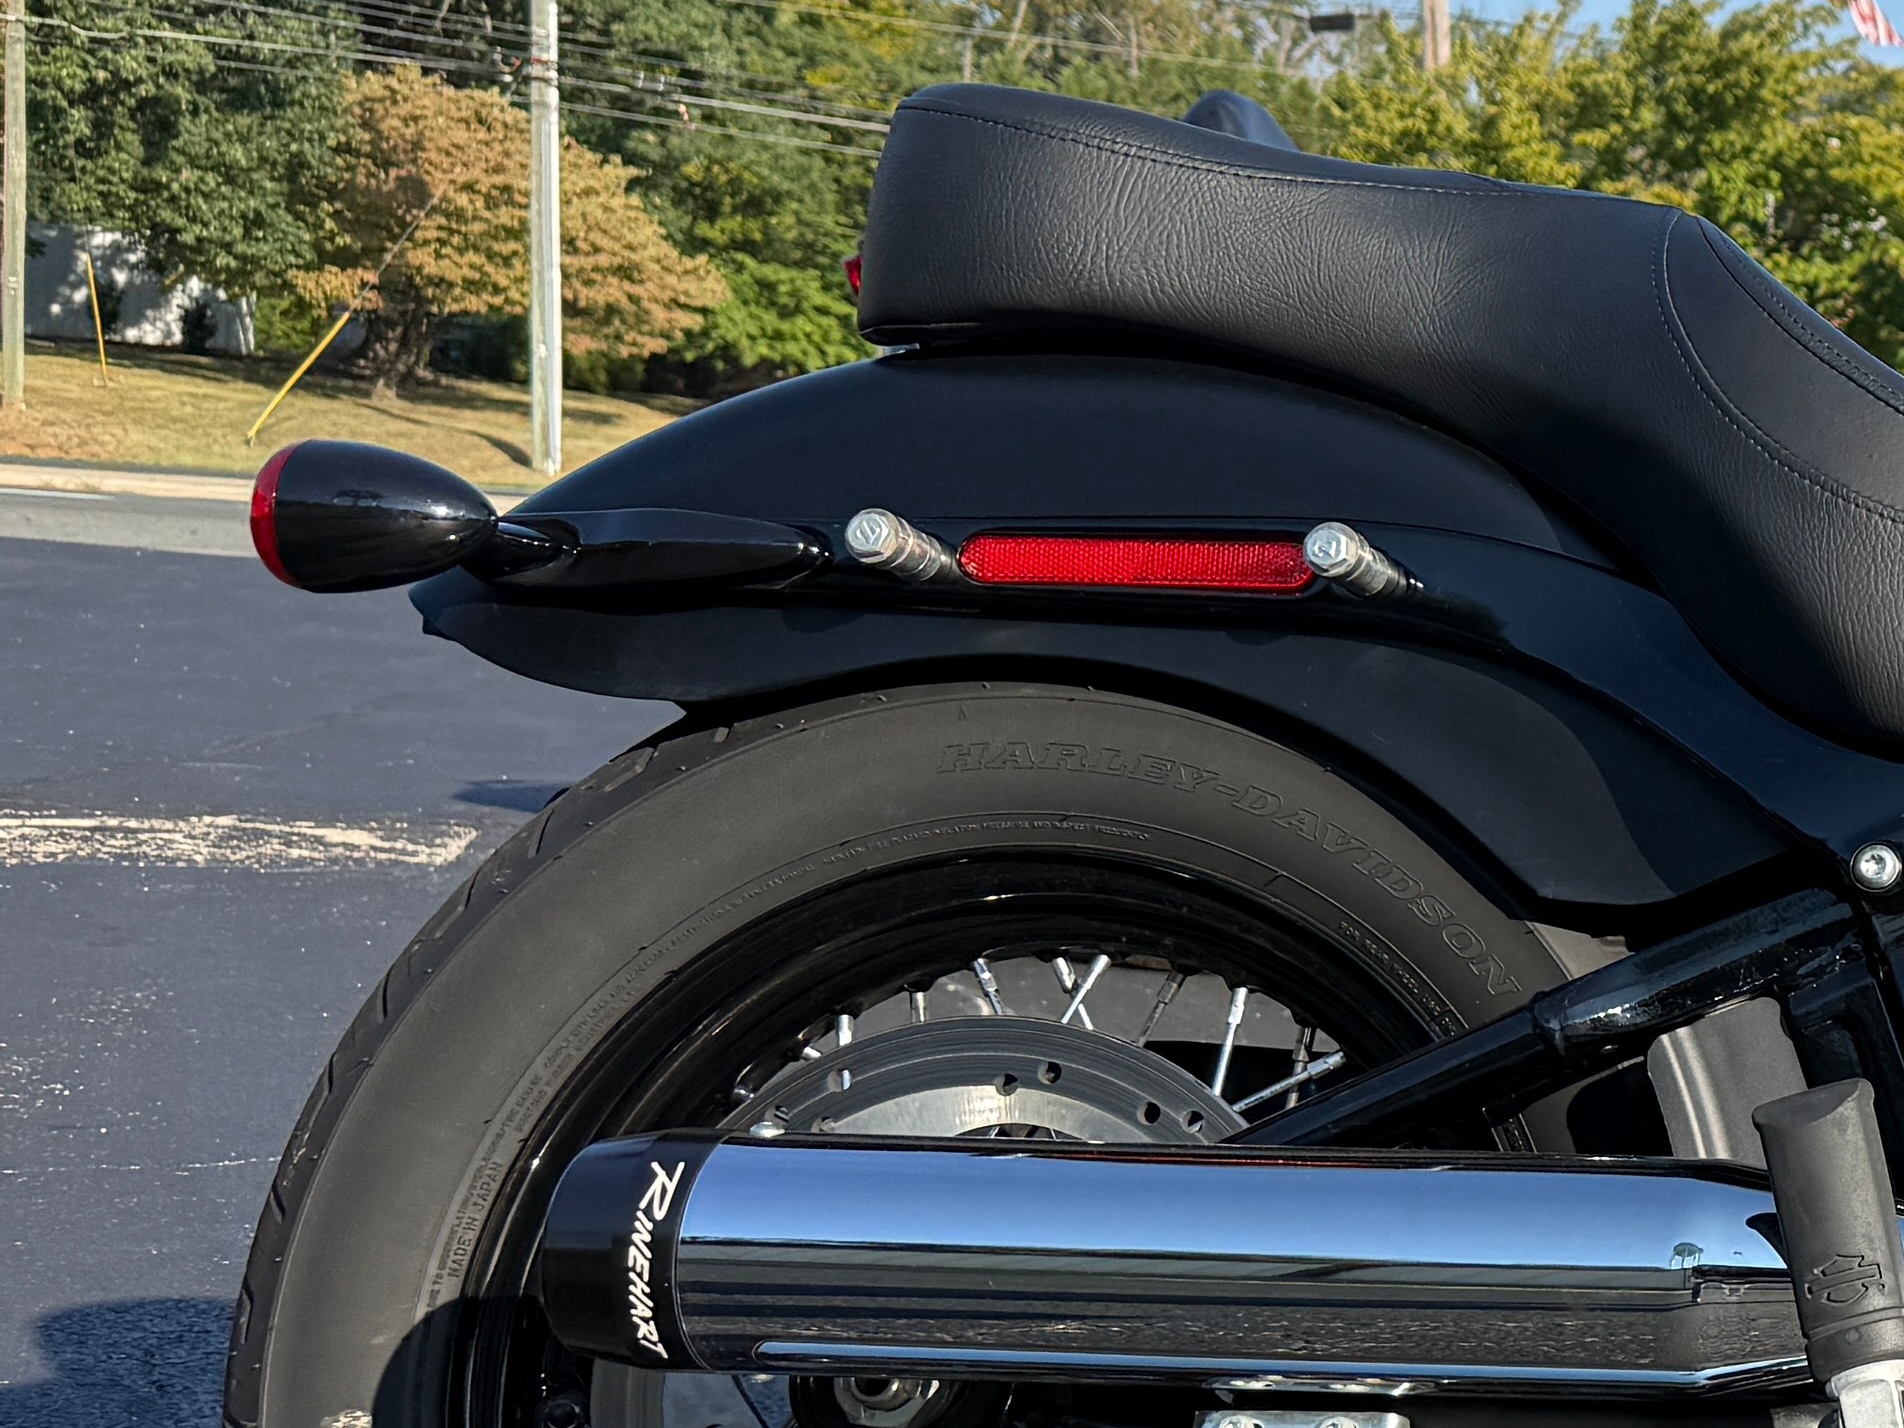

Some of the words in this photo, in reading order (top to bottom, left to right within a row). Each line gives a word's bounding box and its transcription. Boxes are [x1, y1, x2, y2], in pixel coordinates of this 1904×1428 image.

[937, 742, 1525, 1000] HARLEY-DAVIDSON
[445, 1234, 473, 1279] MADE
[461, 1214, 479, 1233] IN
[470, 1159, 505, 1213] JAPAN
[628, 1161, 685, 1359] RINEHART
